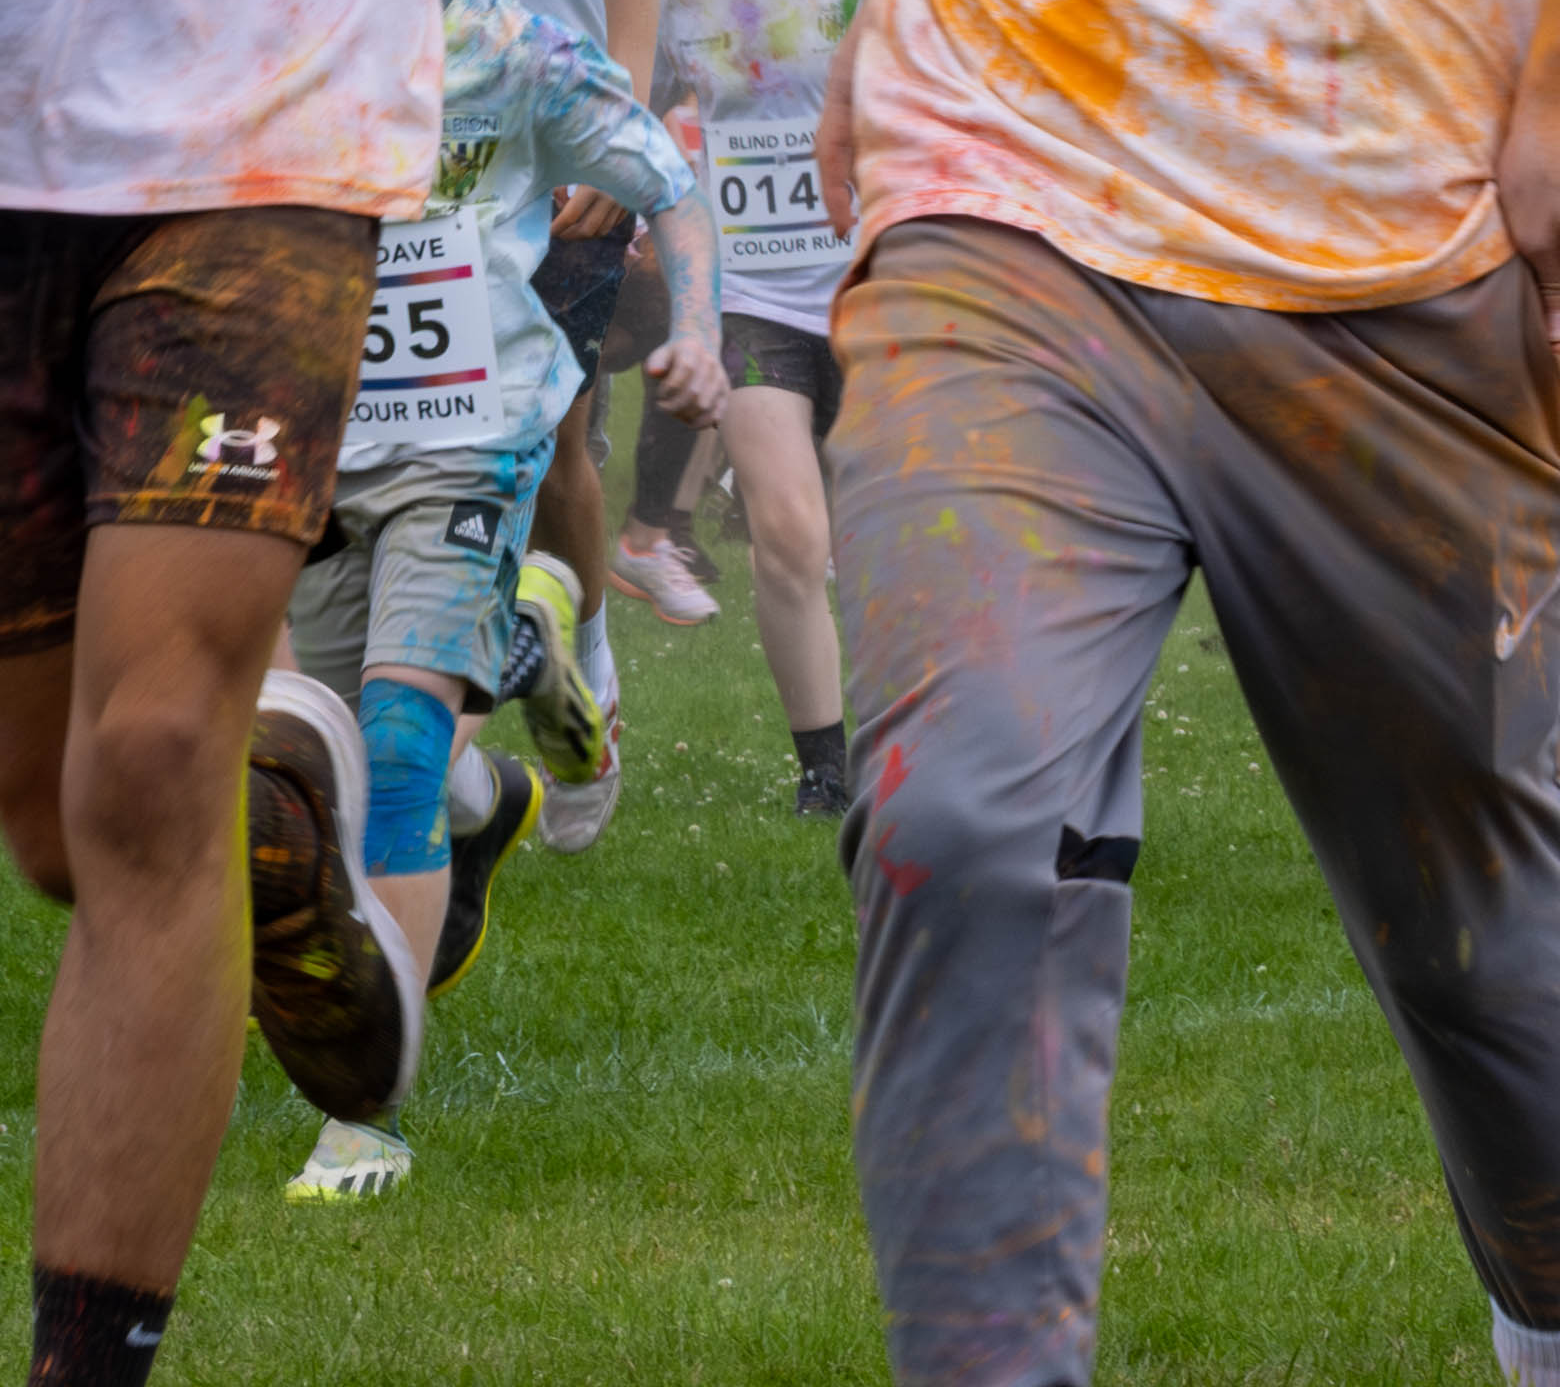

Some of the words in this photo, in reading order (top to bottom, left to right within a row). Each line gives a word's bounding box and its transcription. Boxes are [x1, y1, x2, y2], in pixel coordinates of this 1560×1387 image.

[729, 134, 779, 151] BLIND
[733, 237, 807, 256] COLOUR
[418, 394, 475, 421] RUN
